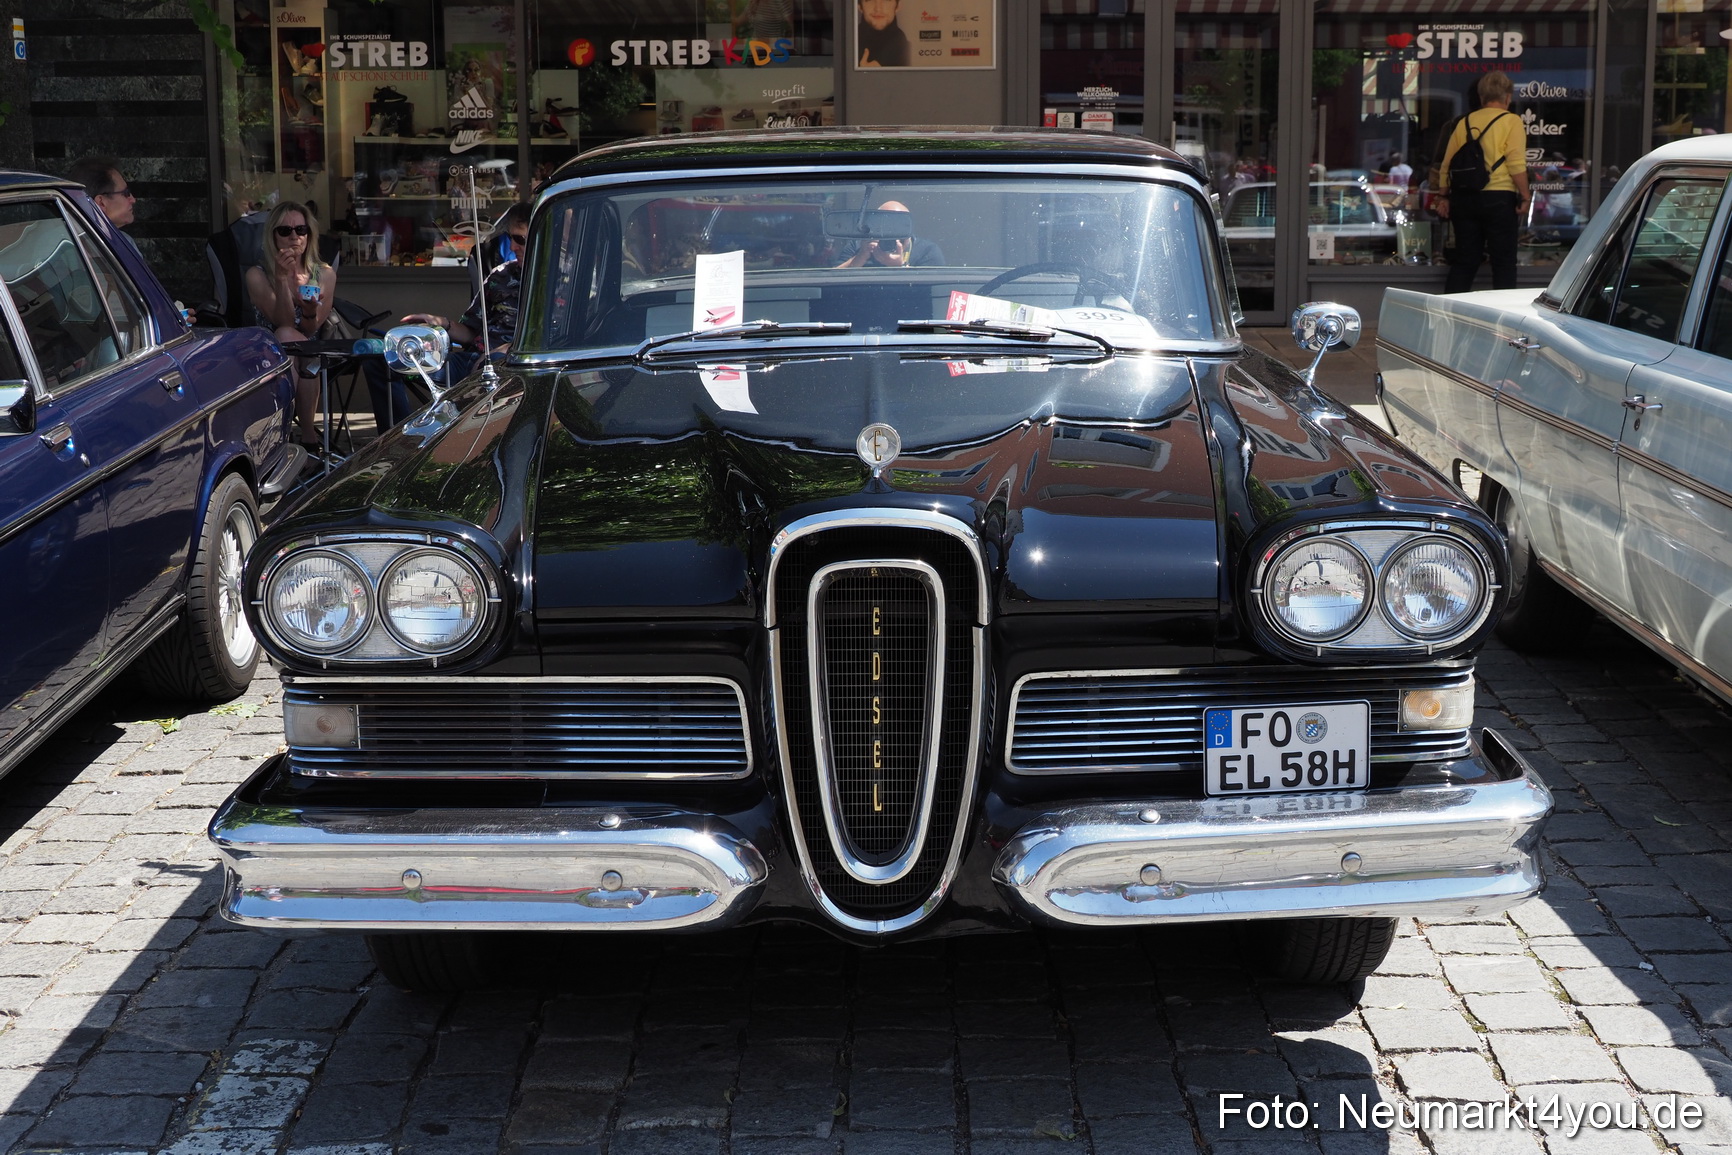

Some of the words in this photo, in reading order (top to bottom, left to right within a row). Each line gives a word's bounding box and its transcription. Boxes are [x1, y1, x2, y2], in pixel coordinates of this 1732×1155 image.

[276, 11, 307, 24] s.Oliver
[610, 39, 711, 66] STREB
[721, 37, 793, 67] KIDS
[1416, 31, 1524, 60] STREB
[329, 41, 429, 67] STREB
[331, 71, 349, 81] AUF
[389, 71, 428, 81] SCHUHE
[762, 84, 806, 99] superfit
[1520, 80, 1568, 98] s.Oliver
[448, 107, 494, 119] adidas
[456, 129, 484, 143] NIKE
[1529, 182, 1565, 191] remonte
[1405, 238, 1427, 247] NEW
[1075, 311, 1125, 321] 395
[872, 606, 882, 812] EDSEL
[1240, 711, 1292, 749] FO
[1215, 734, 1224, 746] D
[1219, 754, 1271, 791] EL
[1281, 749, 1356, 788] 58H
